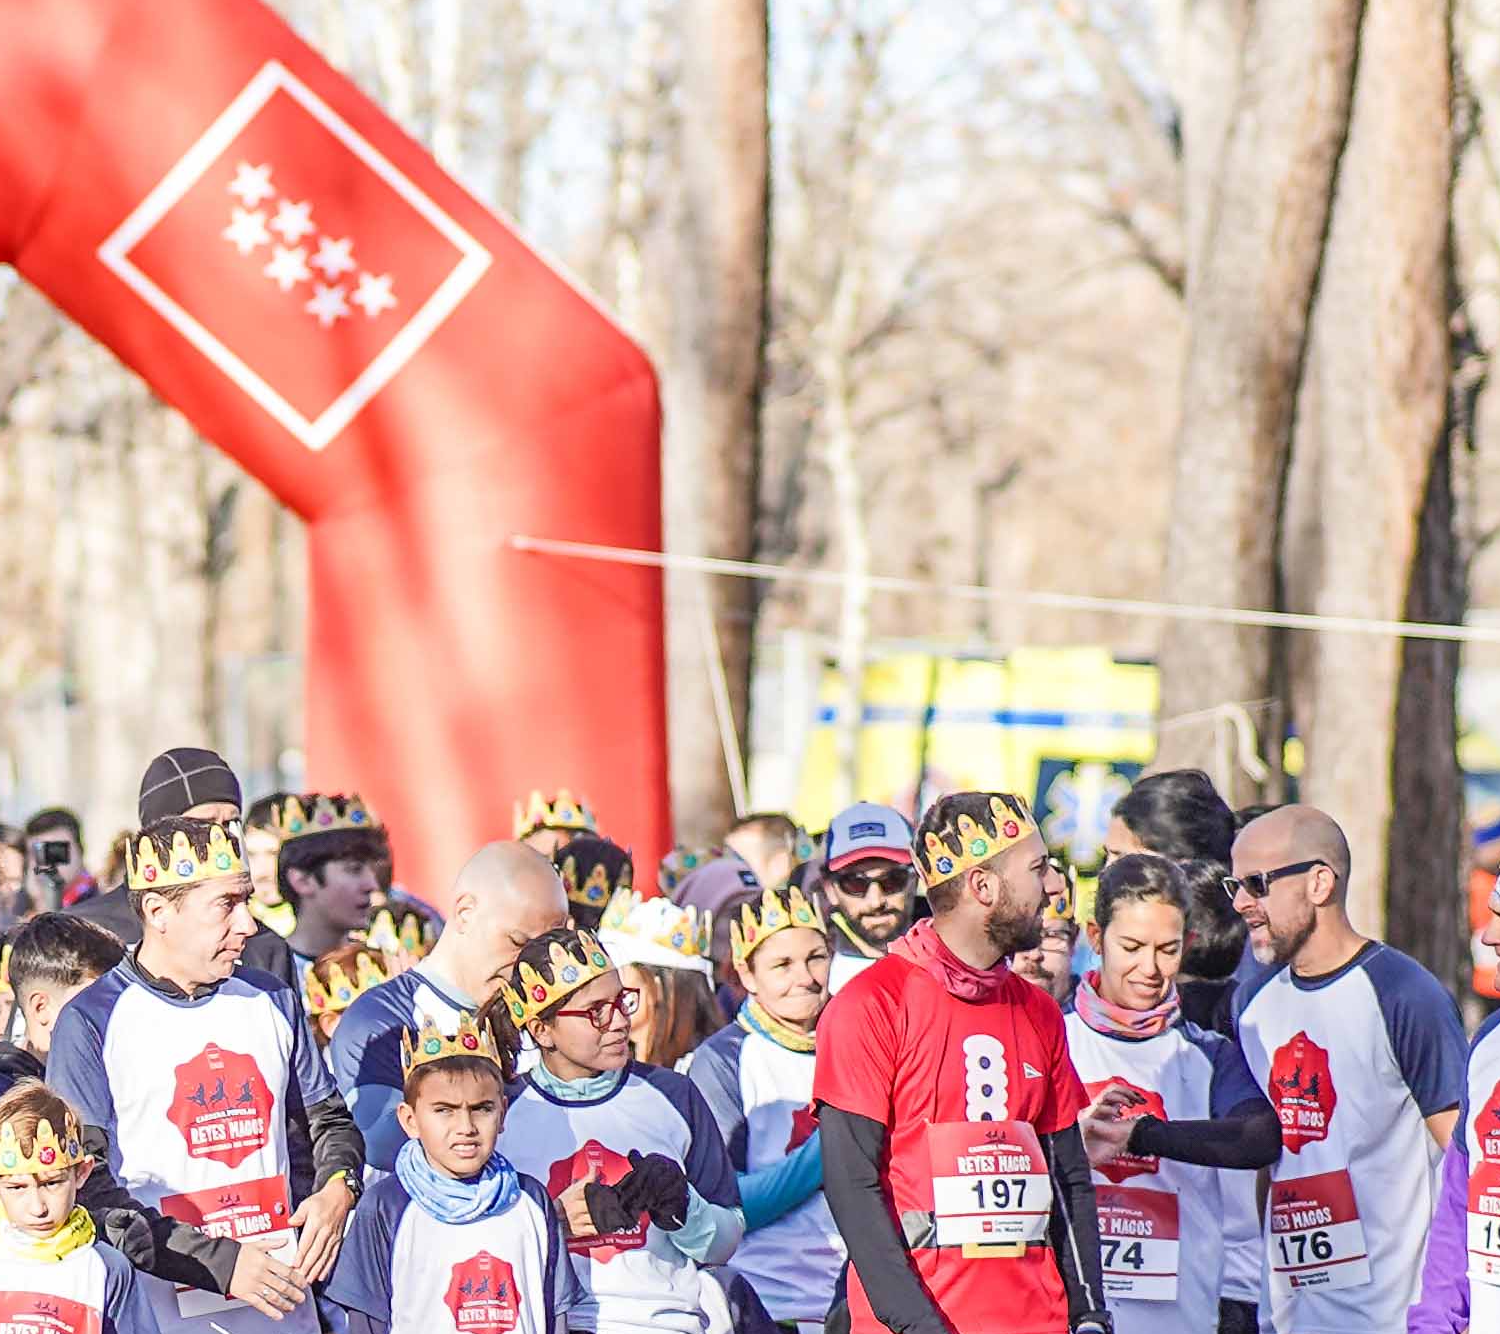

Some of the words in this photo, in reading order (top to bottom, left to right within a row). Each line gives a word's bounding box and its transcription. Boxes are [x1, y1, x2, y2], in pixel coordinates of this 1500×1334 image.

[957, 1155, 996, 1174] REYES
[998, 1155, 1032, 1173] MAGOS
[971, 1179, 1027, 1208] 197
[1111, 1218, 1154, 1236] MAGOS
[1292, 1206, 1332, 1229] MAGOS
[193, 1221, 233, 1240] EYES
[1100, 1239, 1144, 1270] 74
[1278, 1231, 1333, 1266] 176
